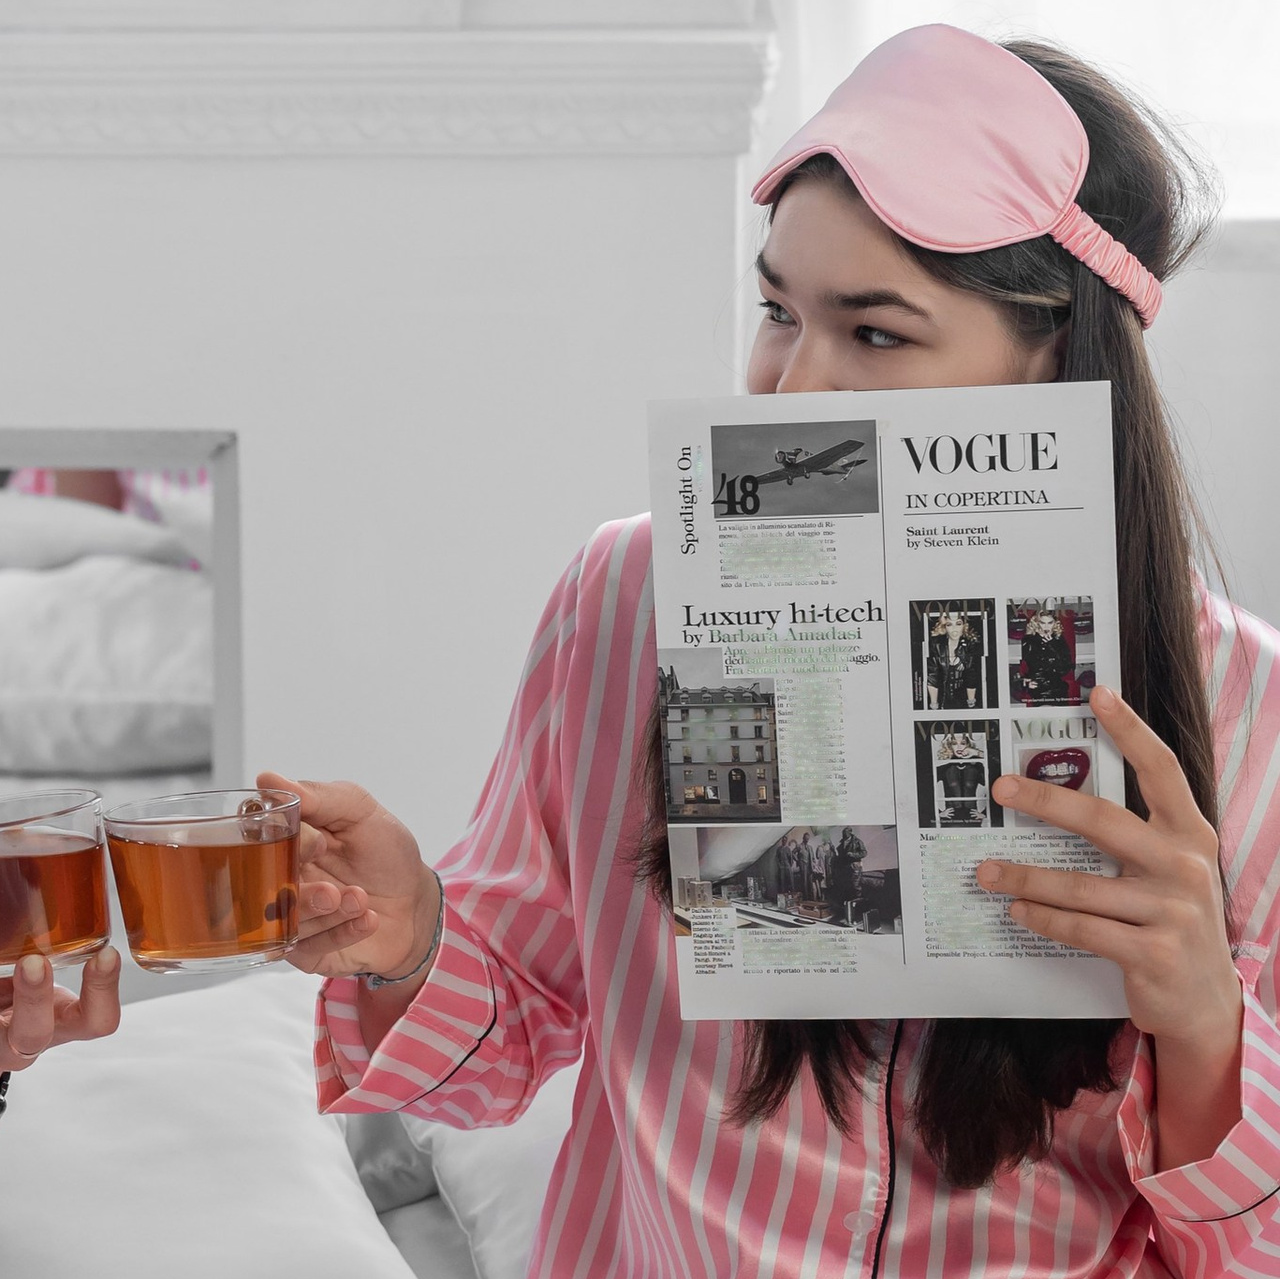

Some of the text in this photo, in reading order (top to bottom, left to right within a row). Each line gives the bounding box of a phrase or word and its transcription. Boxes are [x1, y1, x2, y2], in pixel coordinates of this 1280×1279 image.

[900, 432, 1058, 475] VOGUE
[677, 446, 699, 555] Spotlight On
[711, 473, 760, 515] 48
[905, 489, 1050, 509] IN COPERTINA
[906, 525, 990, 537] Saint Laurent
[906, 536, 1000, 550] by Steven Klein
[682, 599, 885, 631] Luxury hi-tech
[682, 626, 863, 647] by Barbara Amadasi
[840, 653, 881, 666] viaggio.
[1012, 717, 1098, 740] VOGUE
[1011, 832, 1036, 842] pose!
[926, 951, 961, 959] Impossible
[989, 951, 1014, 959] Casting
[1015, 951, 1024, 959] by
[1043, 951, 1068, 959] Shelley
